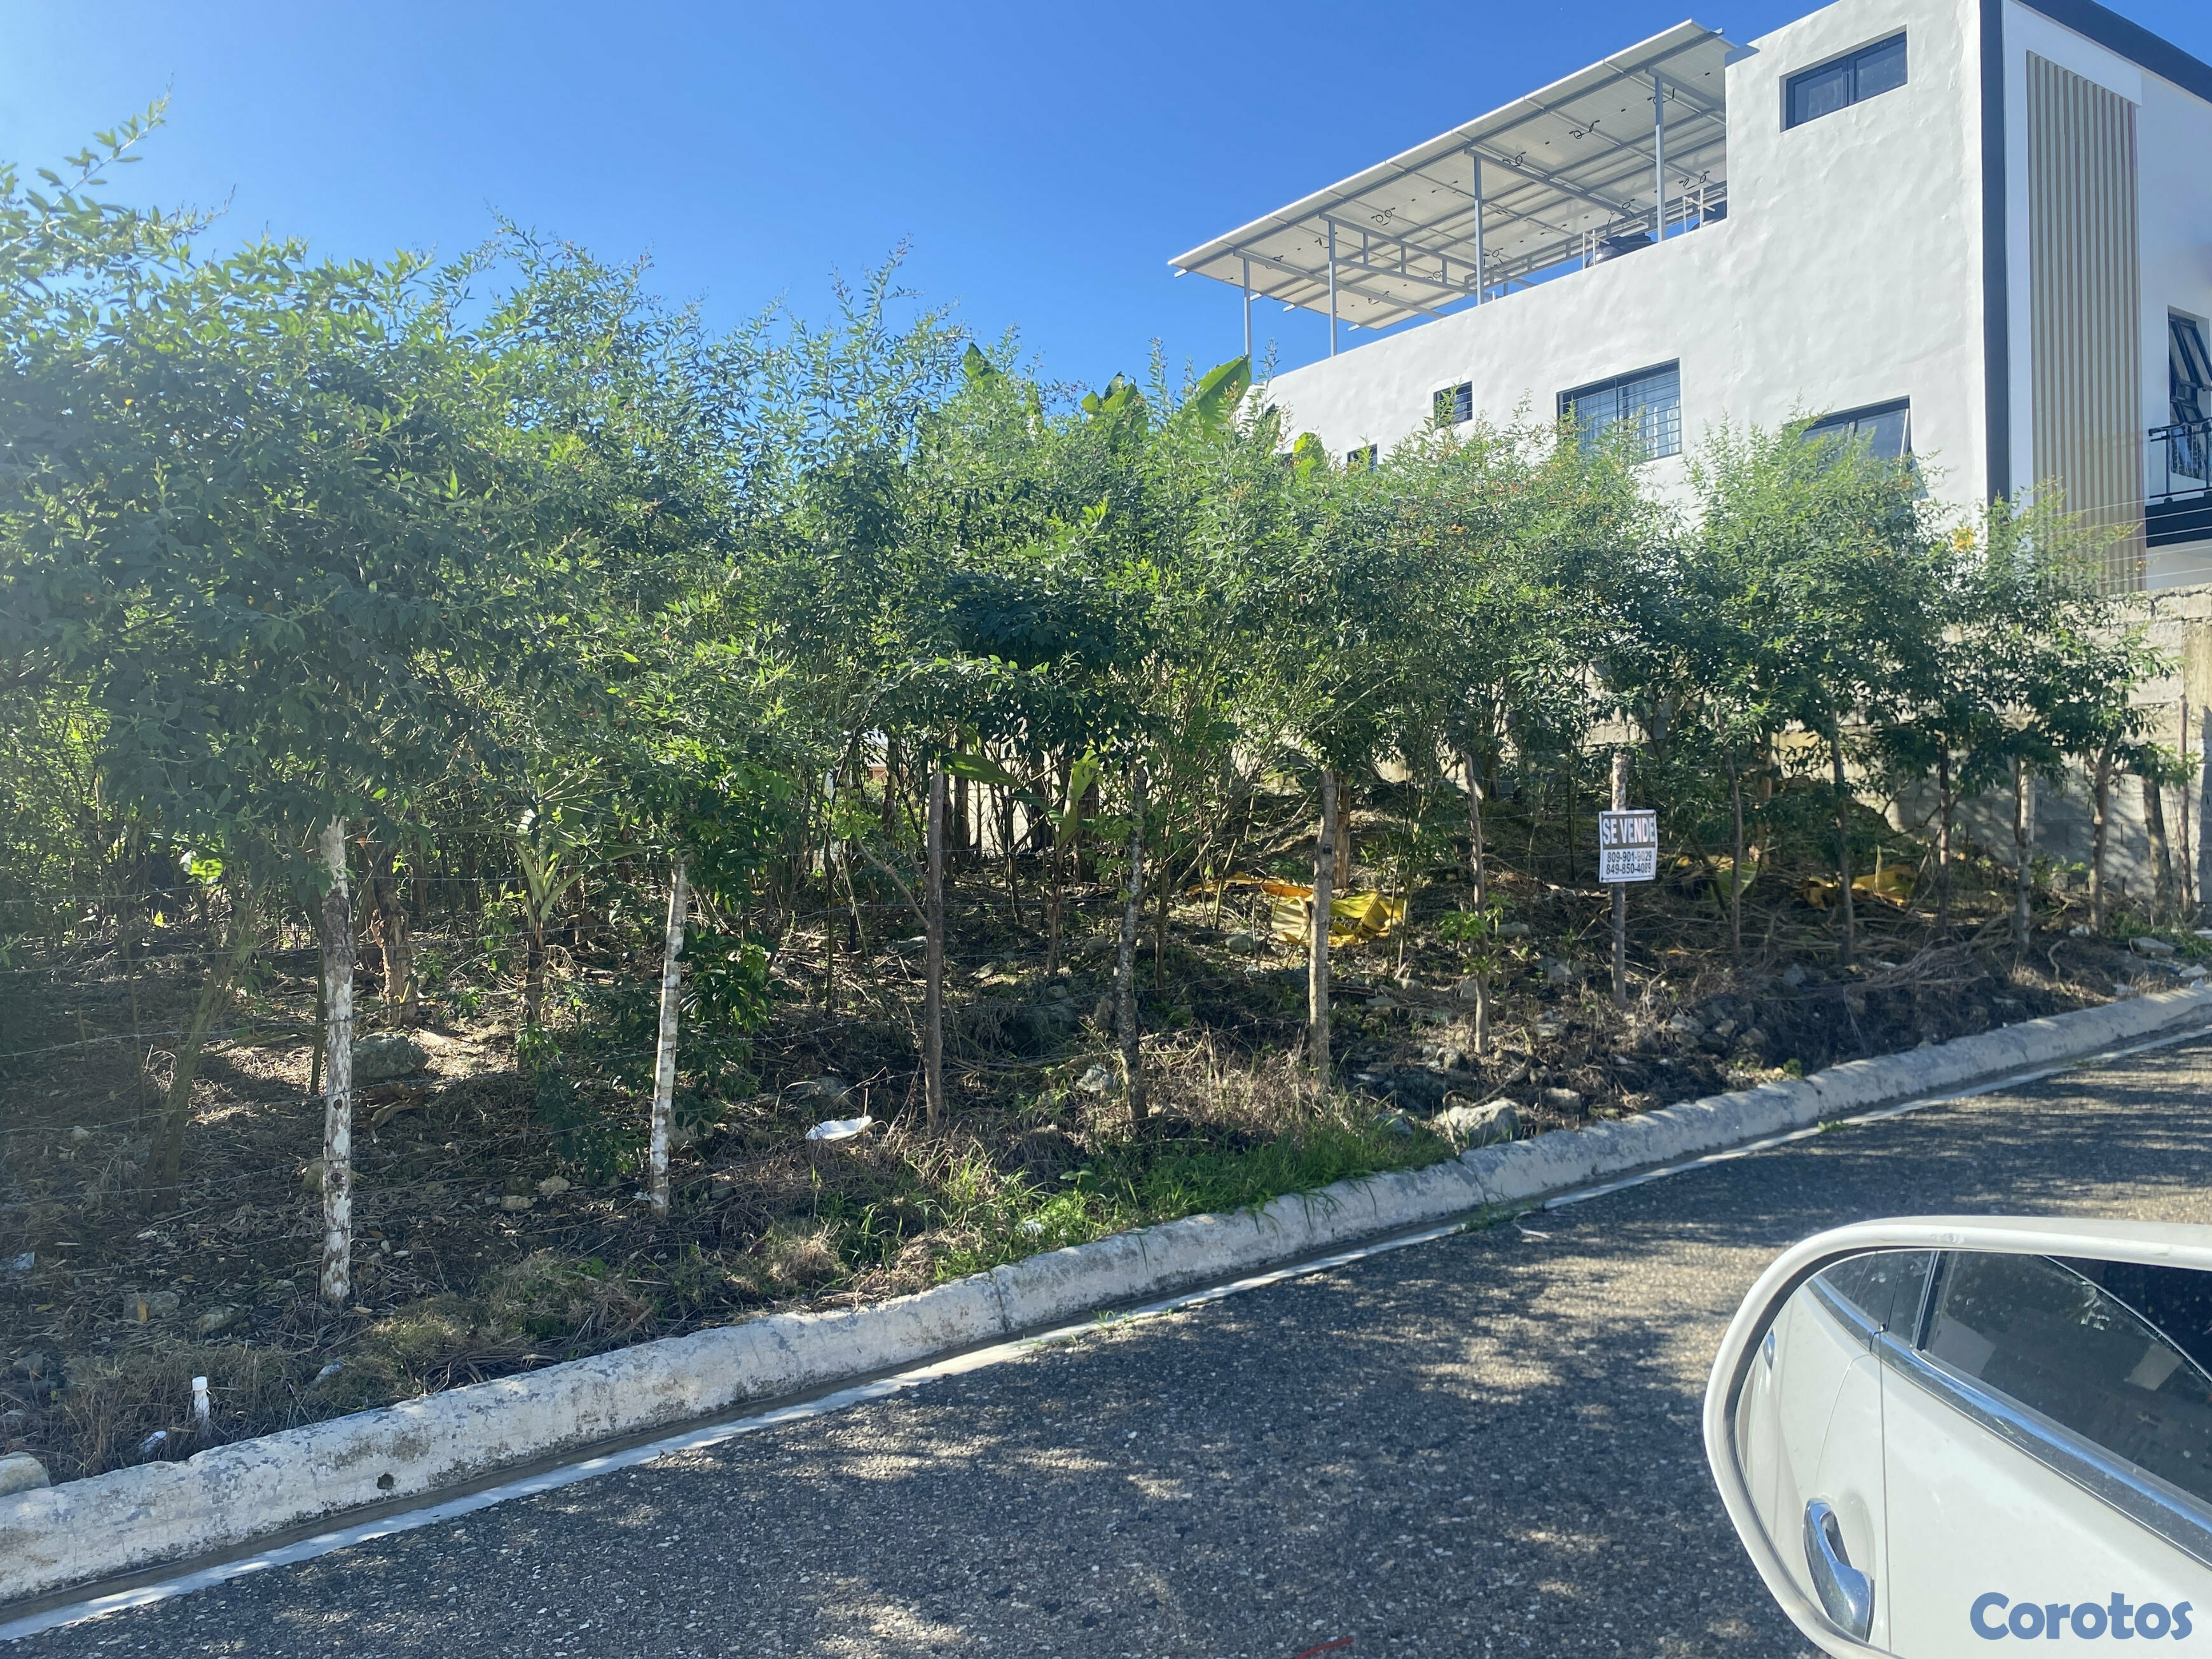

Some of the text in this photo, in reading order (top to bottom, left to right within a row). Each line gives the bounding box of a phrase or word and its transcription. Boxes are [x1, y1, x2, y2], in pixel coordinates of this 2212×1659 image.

[1602, 817, 1656, 845] SE VENDE
[1607, 850, 1652, 863] 809-901-9029
